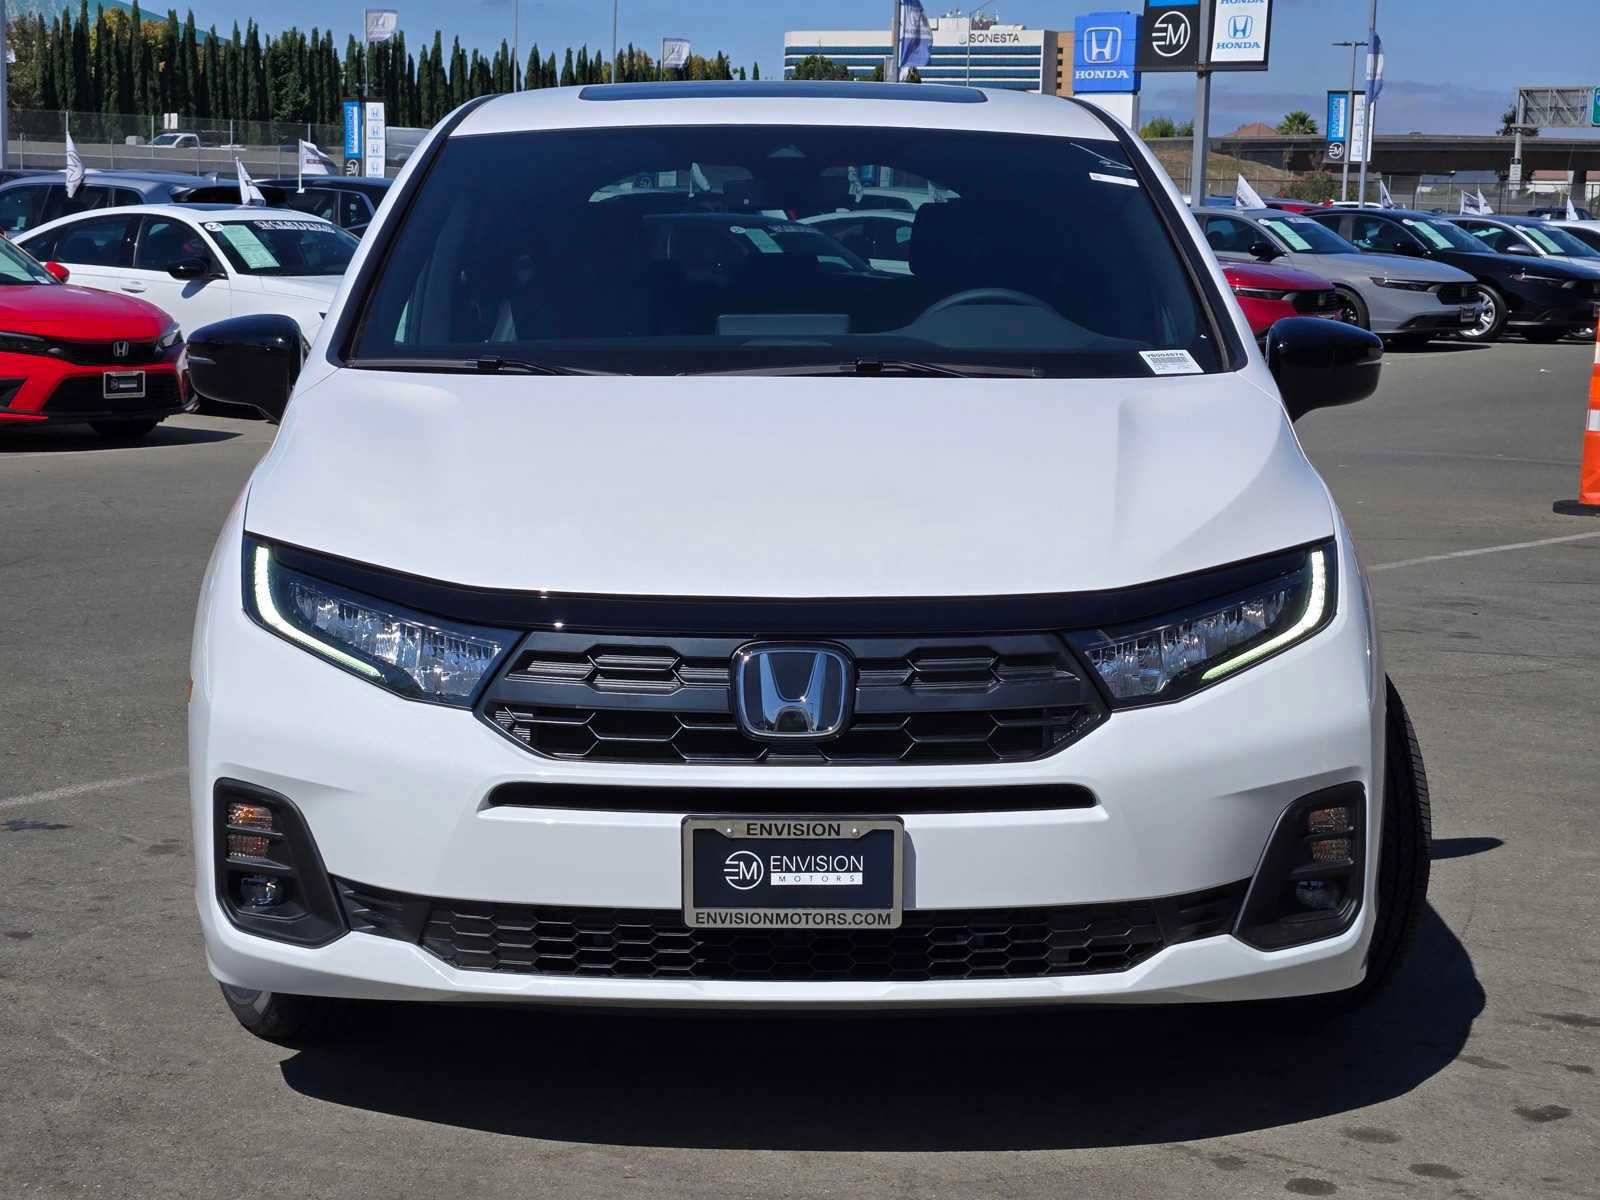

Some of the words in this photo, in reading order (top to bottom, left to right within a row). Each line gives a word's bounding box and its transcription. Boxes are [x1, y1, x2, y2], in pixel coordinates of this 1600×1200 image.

[969, 33, 1020, 43] SONESTA
[1075, 70, 1129, 79] HONDA
[746, 823, 841, 837] ENVISION
[770, 855, 864, 872] ENVISION
[695, 912, 891, 925] ENVISIONMOTORS.COM
